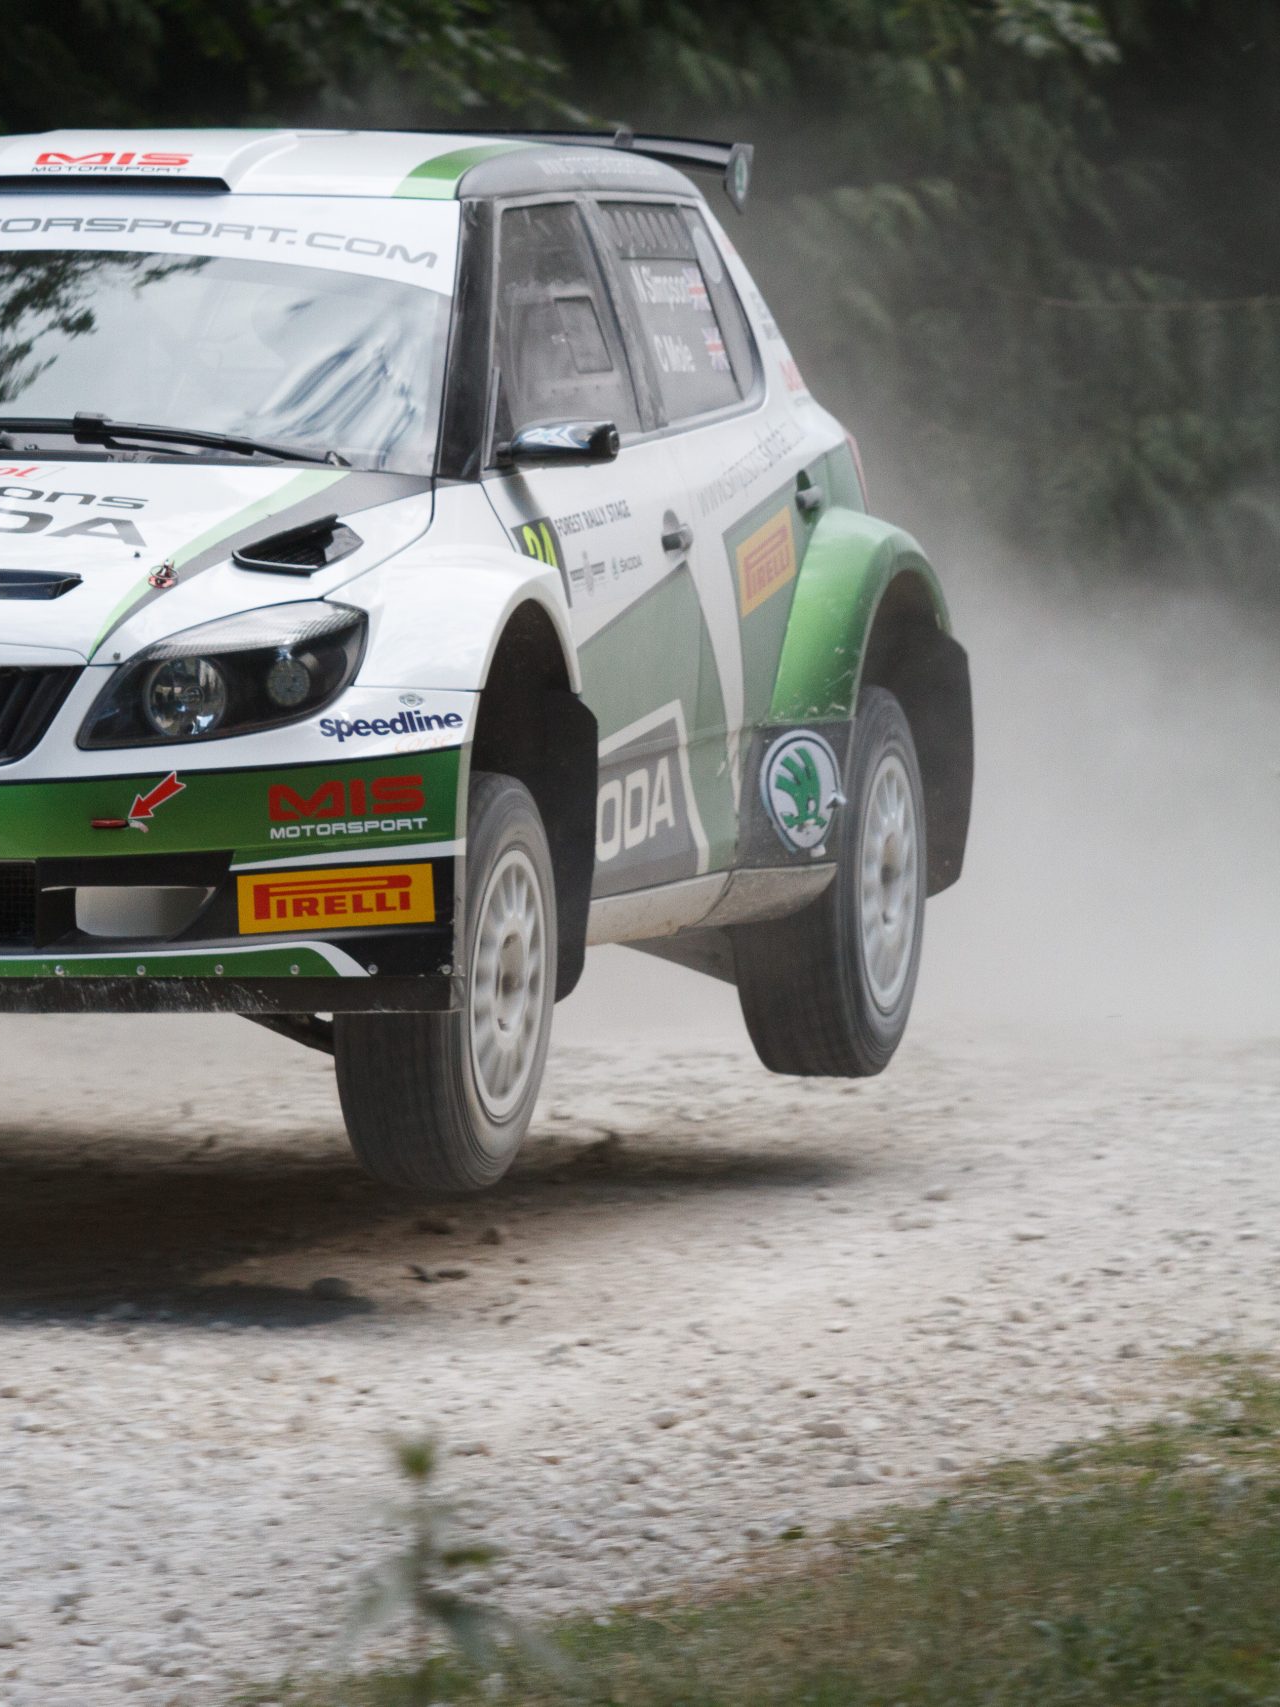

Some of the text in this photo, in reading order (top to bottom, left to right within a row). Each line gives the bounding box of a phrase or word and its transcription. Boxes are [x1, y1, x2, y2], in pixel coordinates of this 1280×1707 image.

[31, 165, 187, 174] MOTORSPORT
[35, 152, 193, 166] MIS
[554, 499, 631, 537] FOREST RALLY STAGE
[744, 524, 790, 601] PIRELLI
[320, 710, 464, 743] speedline
[268, 775, 426, 822] MIS
[270, 817, 428, 840] MOTORSPORT
[253, 875, 412, 921] PIRELLI
